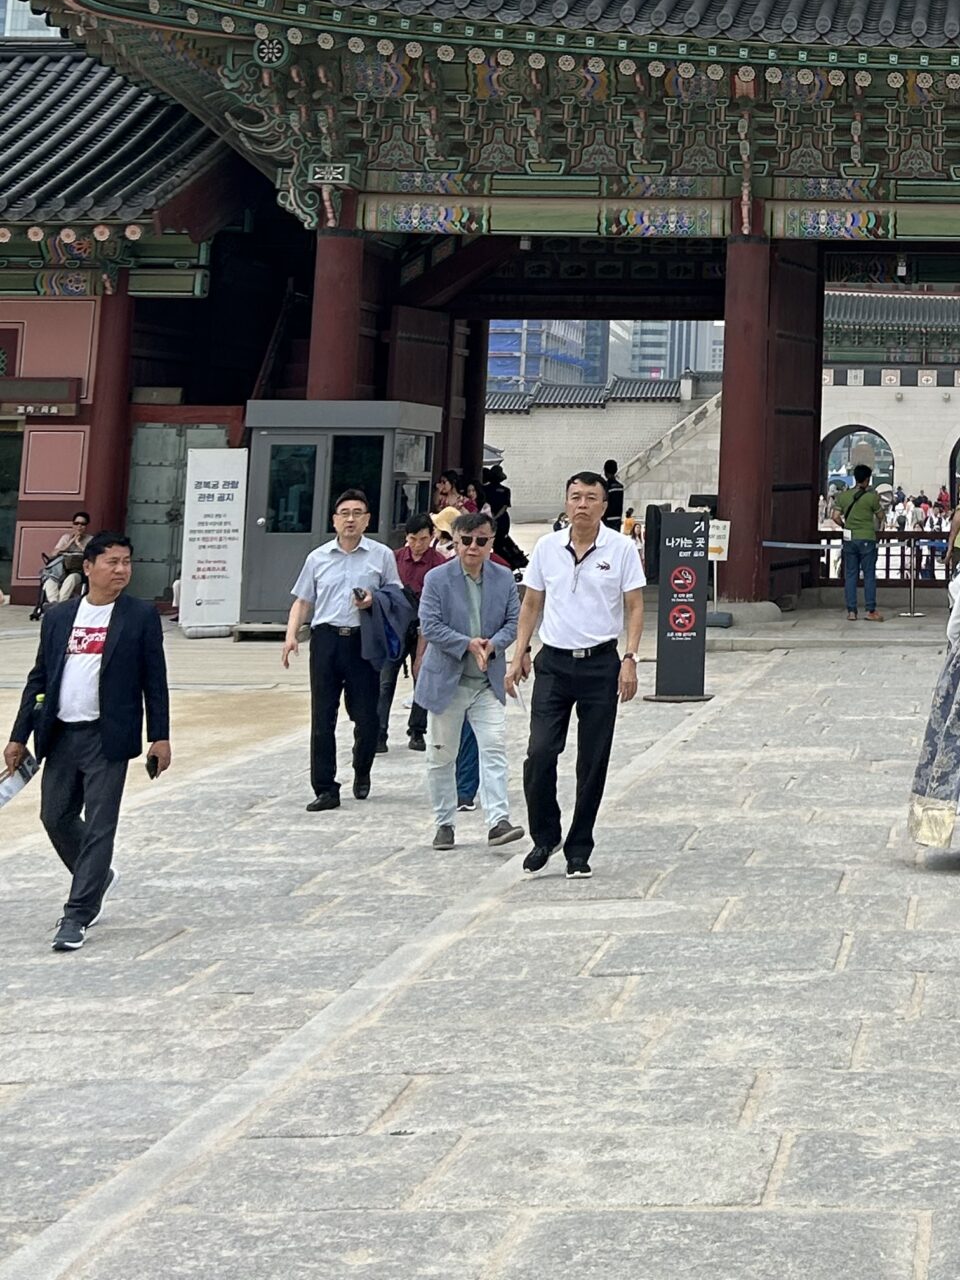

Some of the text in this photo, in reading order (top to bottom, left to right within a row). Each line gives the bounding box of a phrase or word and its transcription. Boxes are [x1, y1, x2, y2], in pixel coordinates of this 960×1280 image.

[194, 480, 239, 490] 경복궁 관람
[197, 492, 234, 502] 관련 공지
[665, 537, 693, 548] 나가는
[695, 537, 705, 548] 곳
